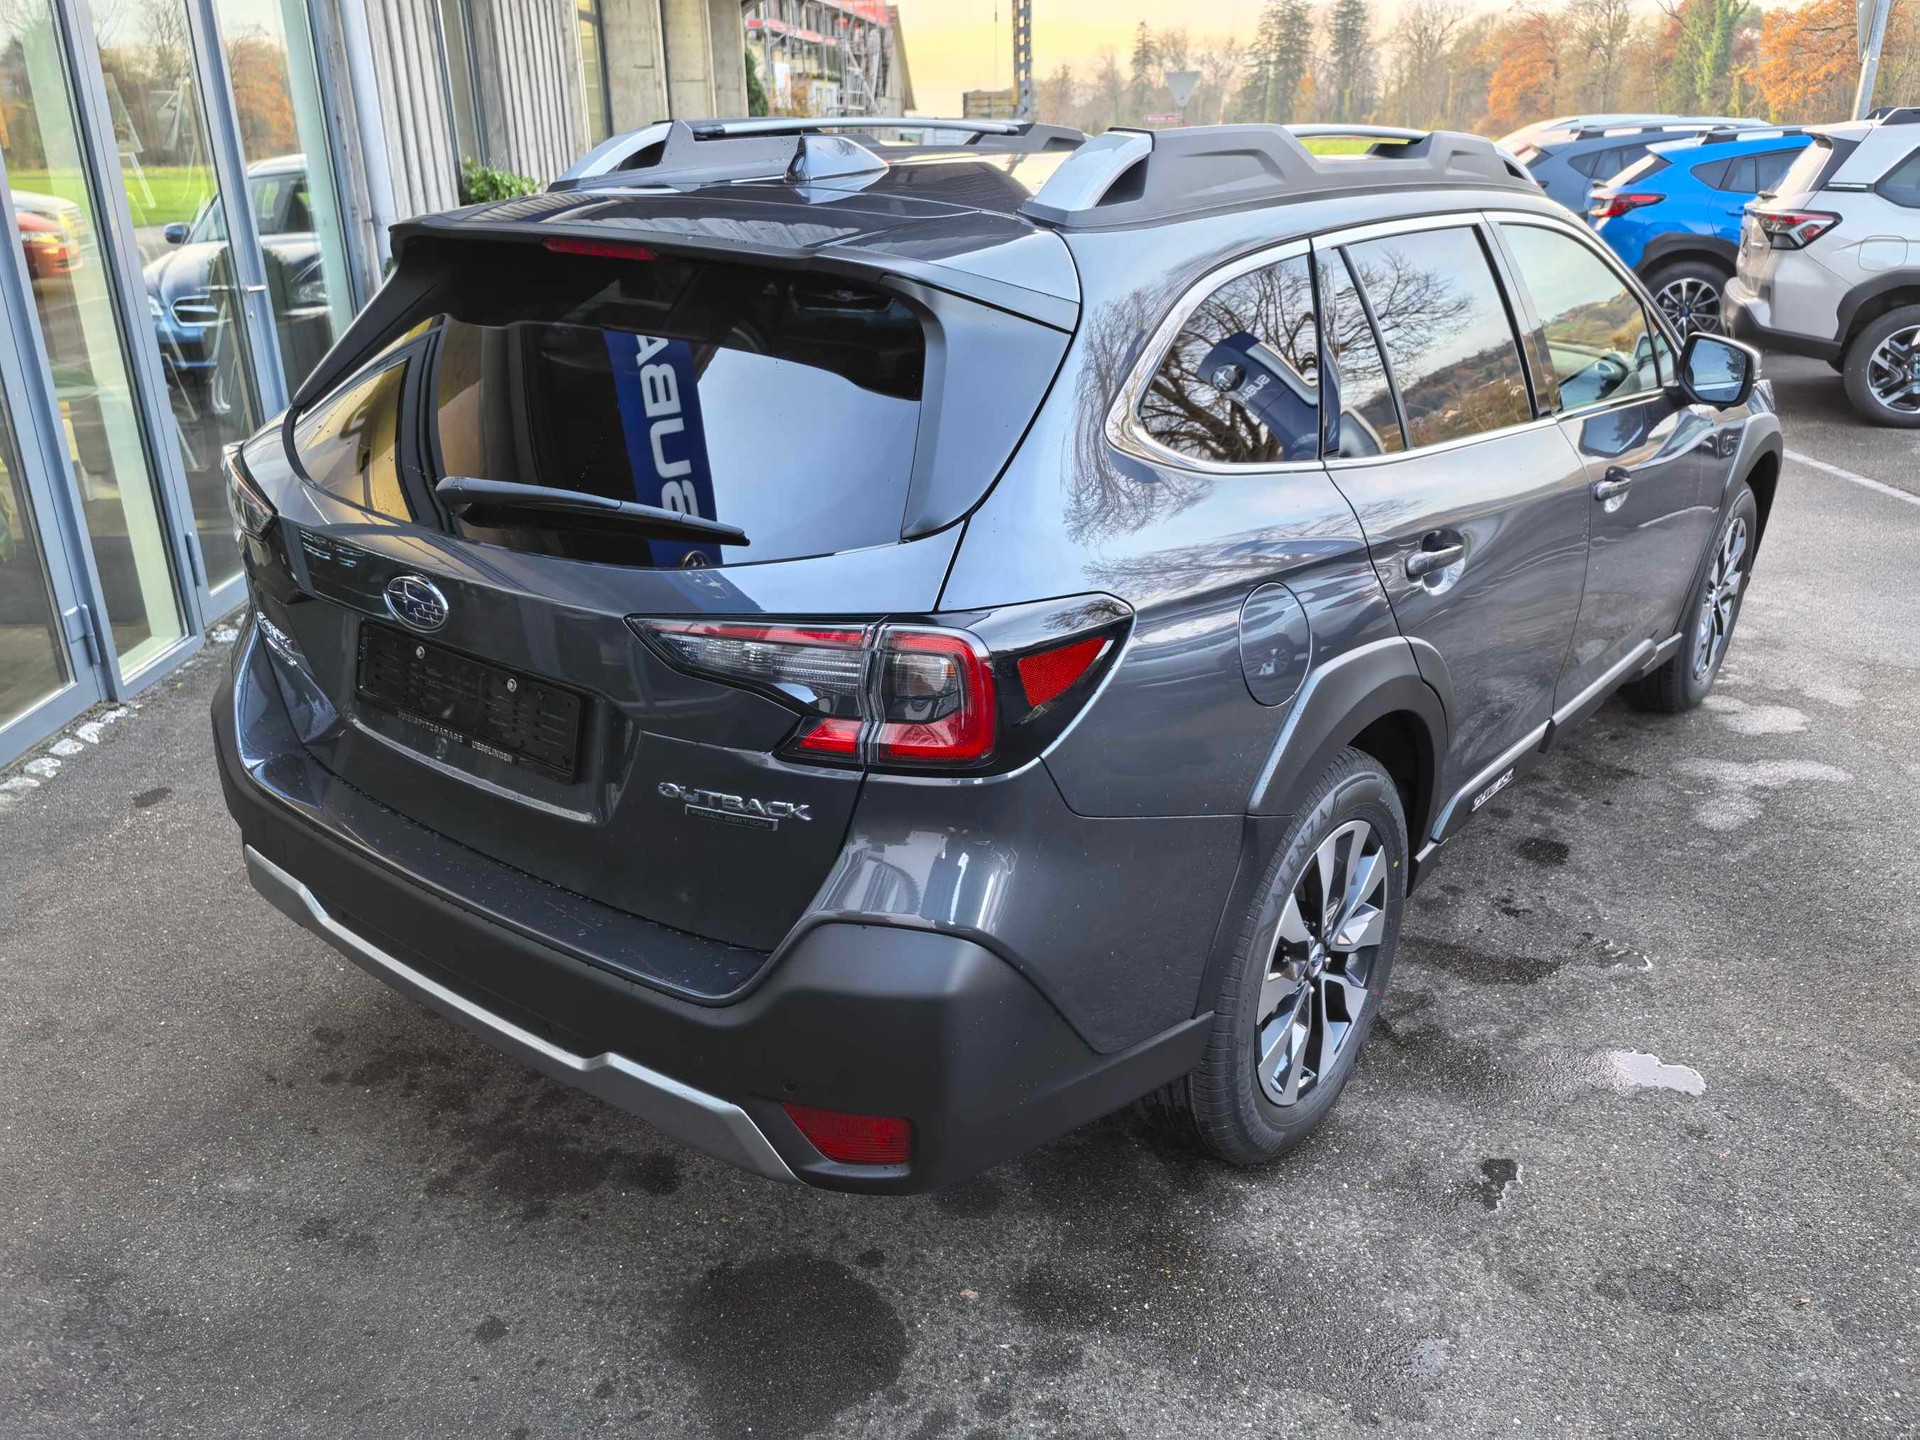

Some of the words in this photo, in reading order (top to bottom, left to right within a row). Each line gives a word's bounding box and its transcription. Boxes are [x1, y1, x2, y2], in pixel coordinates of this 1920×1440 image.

[657, 781, 812, 822] OUTBACK
[690, 809, 725, 822] FINAL
[725, 814, 769, 828] EDITION
[1271, 808, 1328, 908] ALENZA
